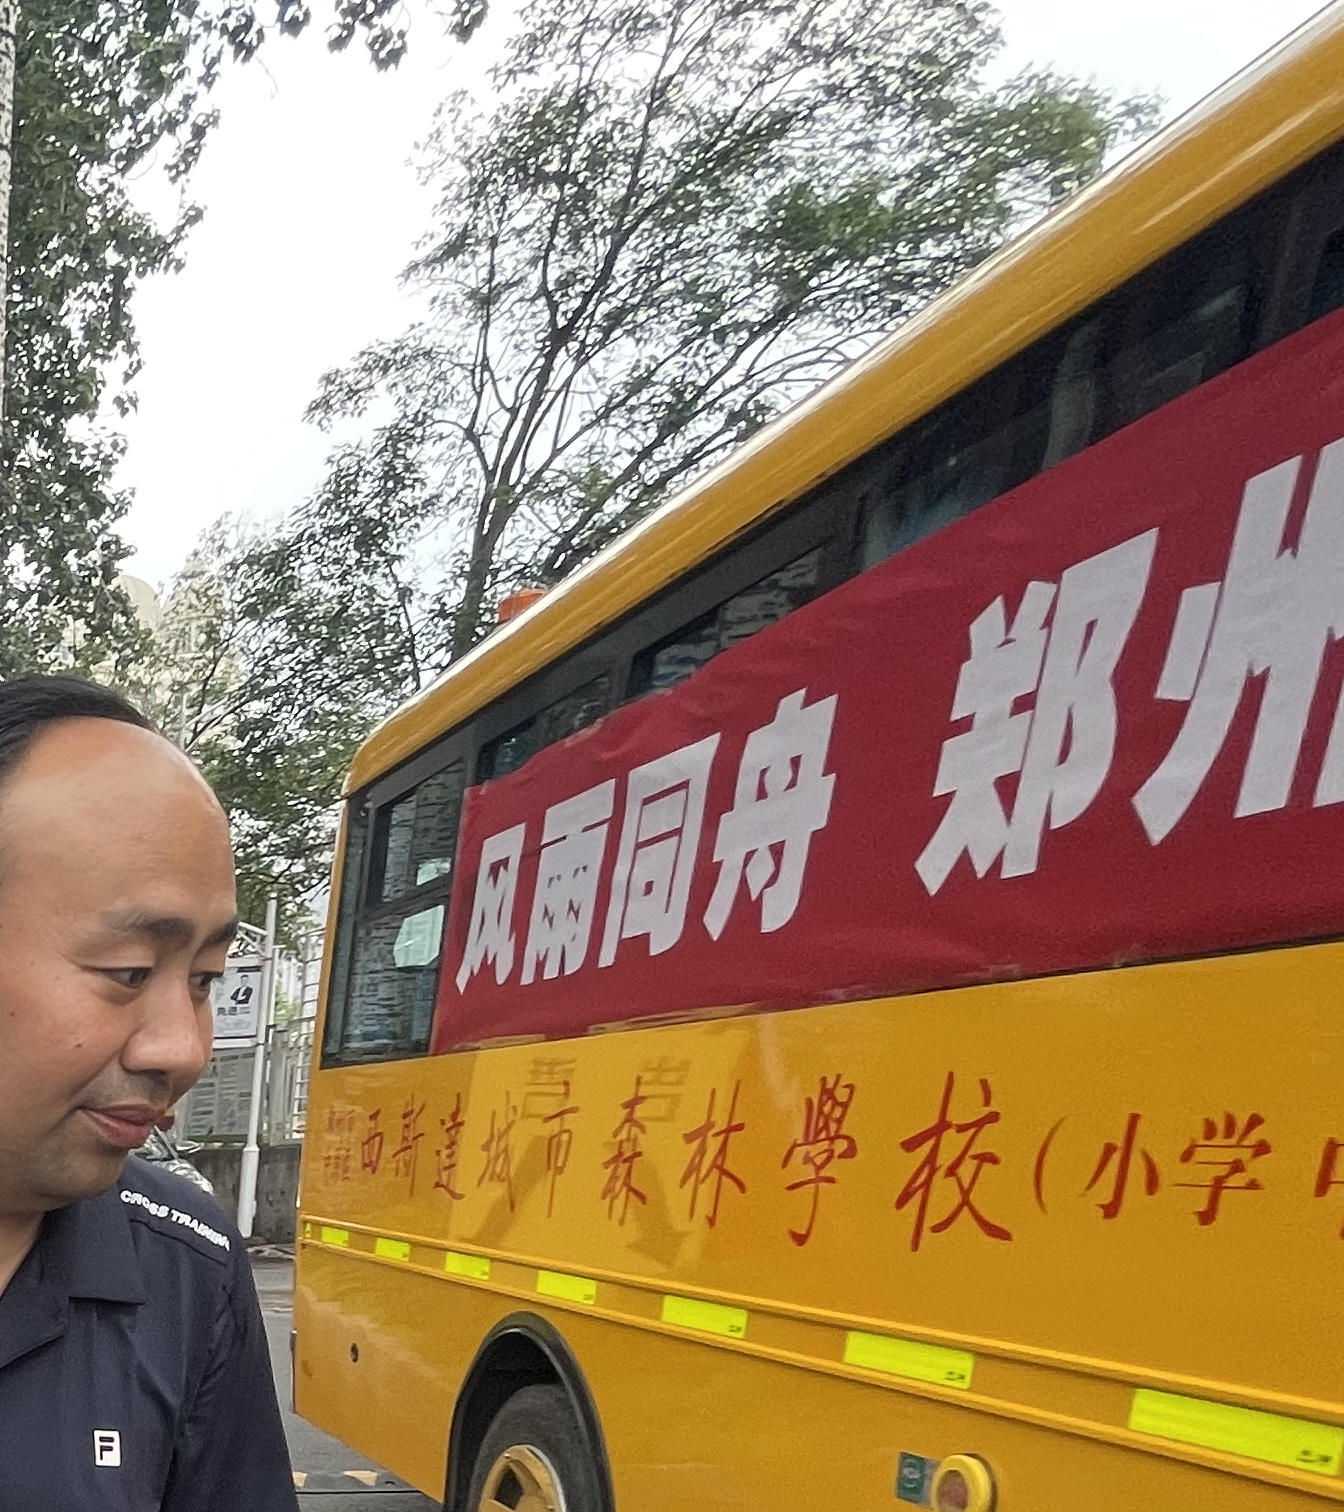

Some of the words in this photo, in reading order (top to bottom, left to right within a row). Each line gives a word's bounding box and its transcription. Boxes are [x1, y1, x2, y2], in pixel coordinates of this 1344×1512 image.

[454, 690, 838, 994] 风雨同舟
[120, 1189, 170, 1218] CROSS
